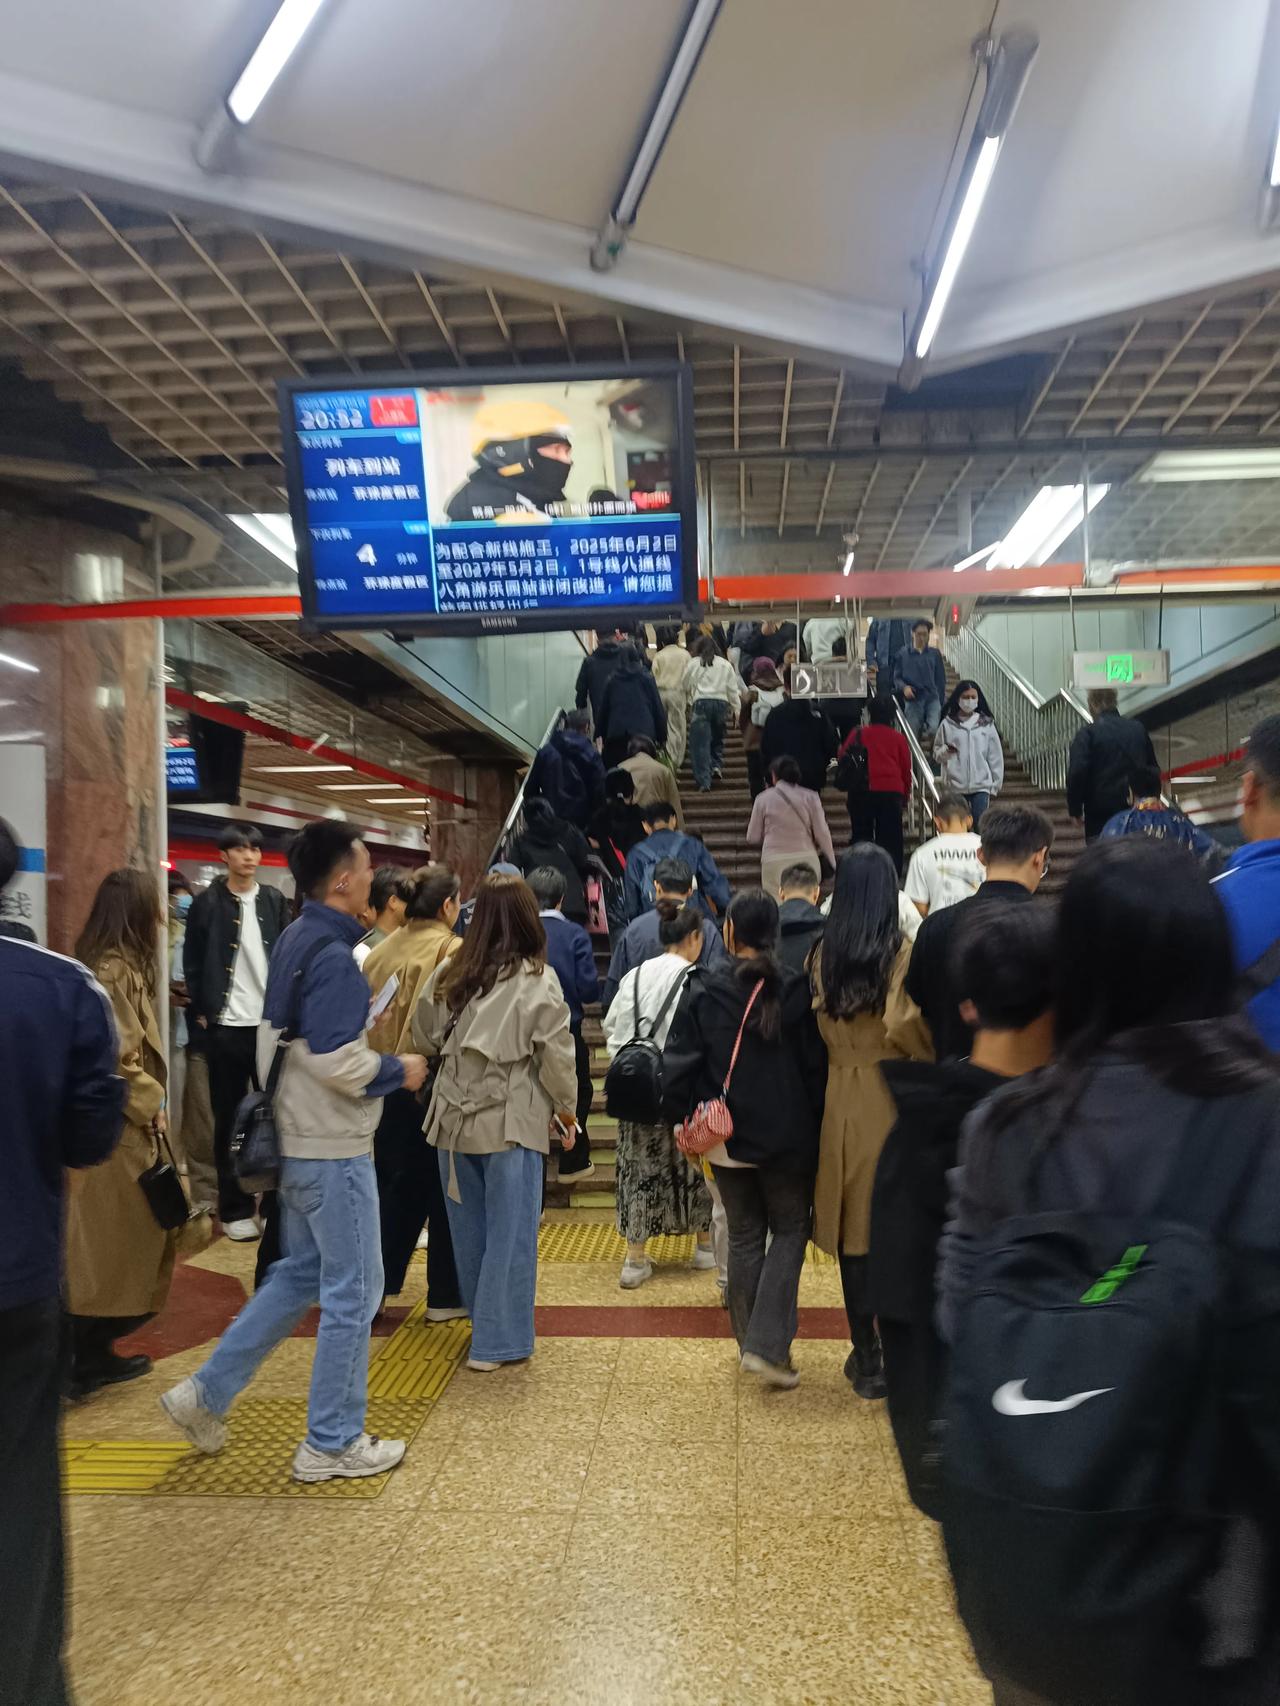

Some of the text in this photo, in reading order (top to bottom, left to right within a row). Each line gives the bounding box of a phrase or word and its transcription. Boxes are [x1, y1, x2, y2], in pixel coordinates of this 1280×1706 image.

[325, 456, 401, 477] 列车到站
[356, 543, 377, 566] 4
